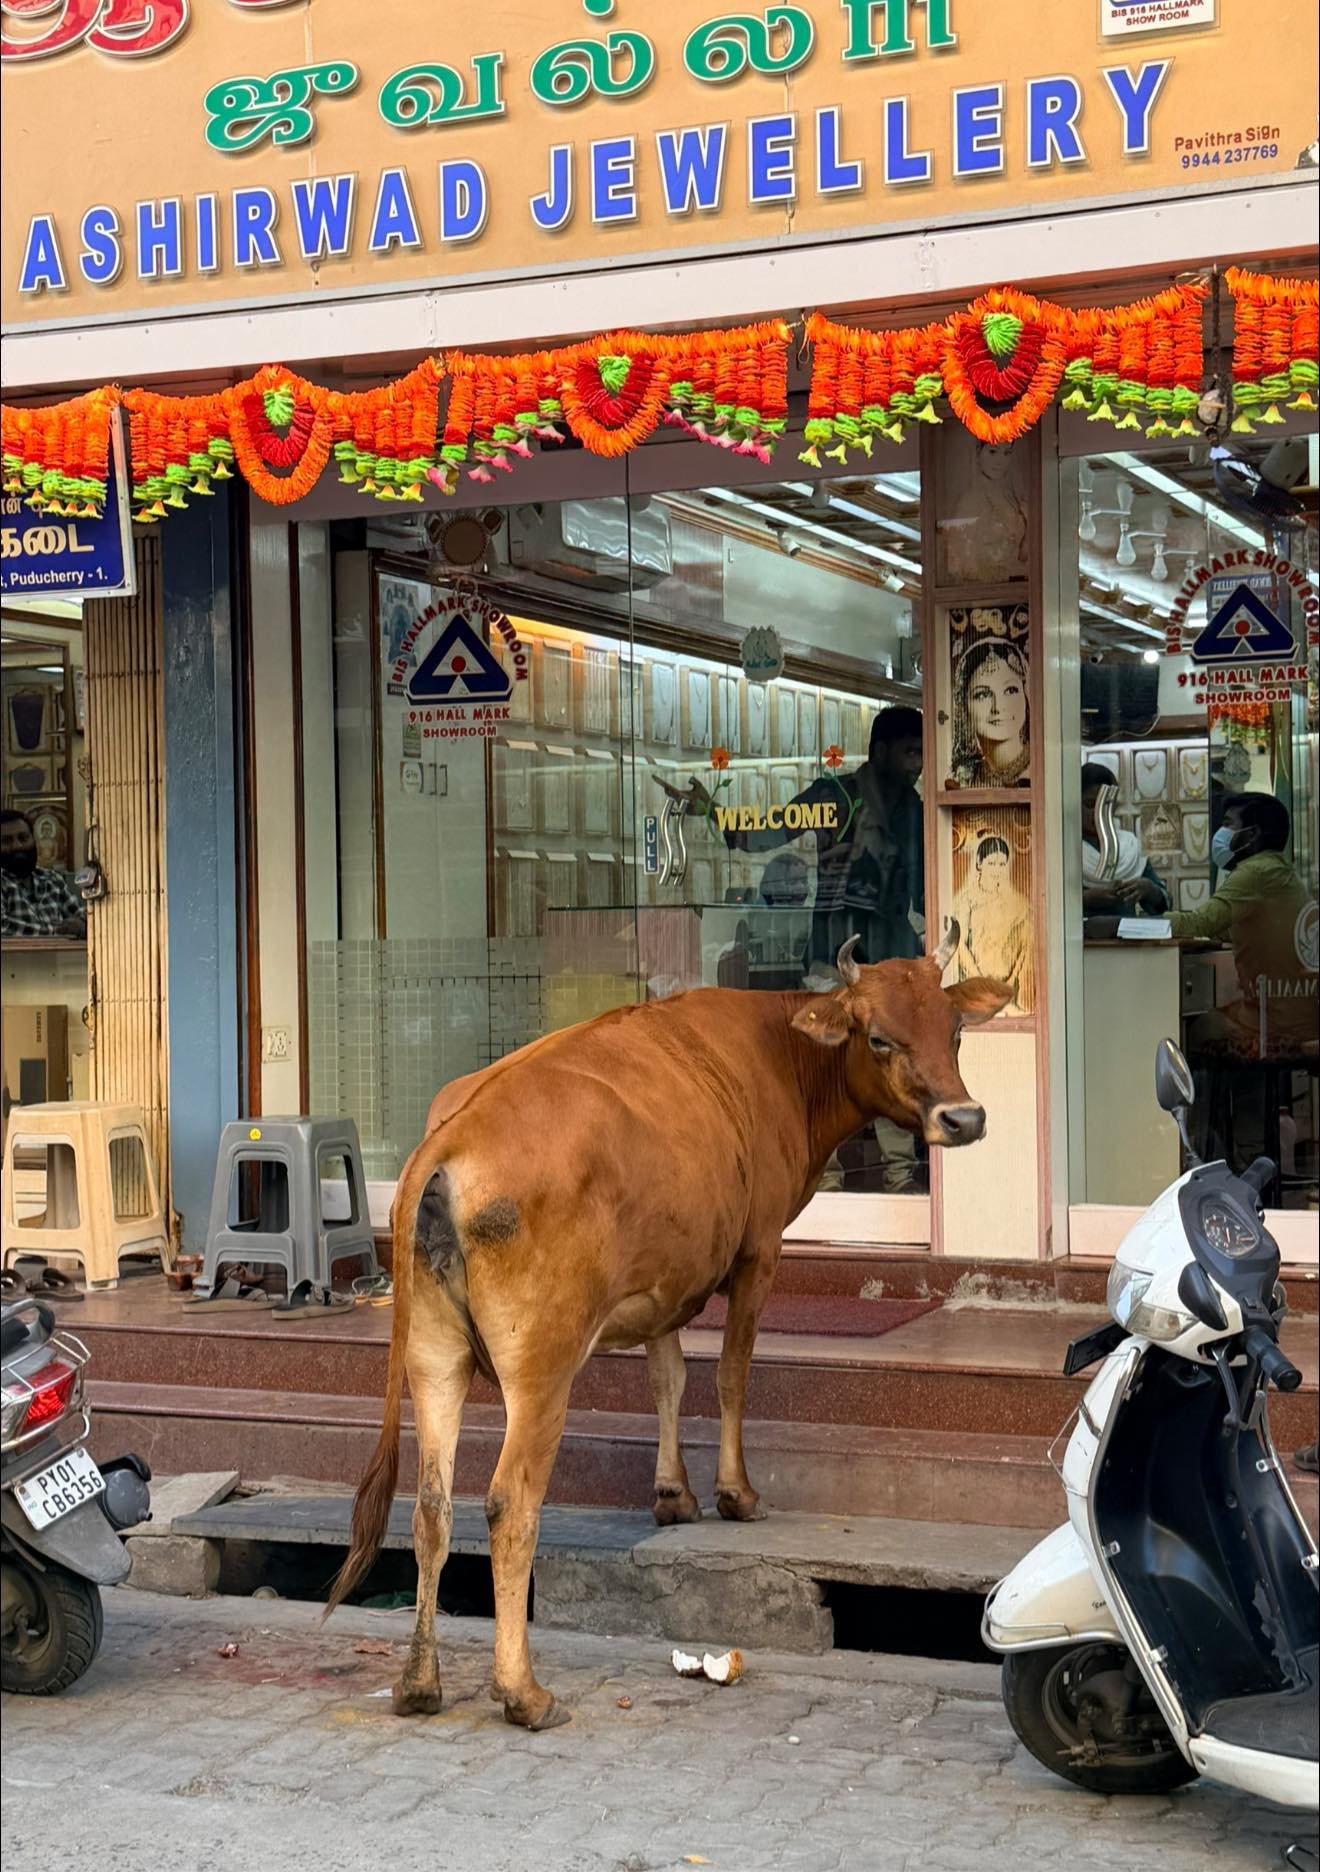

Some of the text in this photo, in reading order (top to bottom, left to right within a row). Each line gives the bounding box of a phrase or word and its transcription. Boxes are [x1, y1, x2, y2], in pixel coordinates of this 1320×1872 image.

[1111, 8, 1127, 18] BIS
[1130, 5, 1147, 15] 916
[1126, 10, 1189, 26] SHOW ROOM
[1174, 125, 1280, 152] Pavithra Sign
[1181, 144, 1278, 169] 9944 237769
[18, 57, 1174, 293] ASHIRWAD JEWELLERY
[10, 568, 84, 587] Puducherry
[1169, 549, 1249, 623] HALLMARK
[391, 596, 528, 683] BIS HALLMARK SHOWROOM
[1166, 625, 1182, 654] BIS
[1177, 666, 1308, 687] 916 HALL MARK
[1195, 689, 1290, 704] SHOWROOM
[409, 707, 510, 723] 916 HALL MARK
[423, 727, 497, 738] SHOWROOM
[715, 802, 838, 832] WELCOME
[646, 818, 657, 872] PULL
[37, 1459, 76, 1495] PY01
[42, 1470, 102, 1519] CB6356
